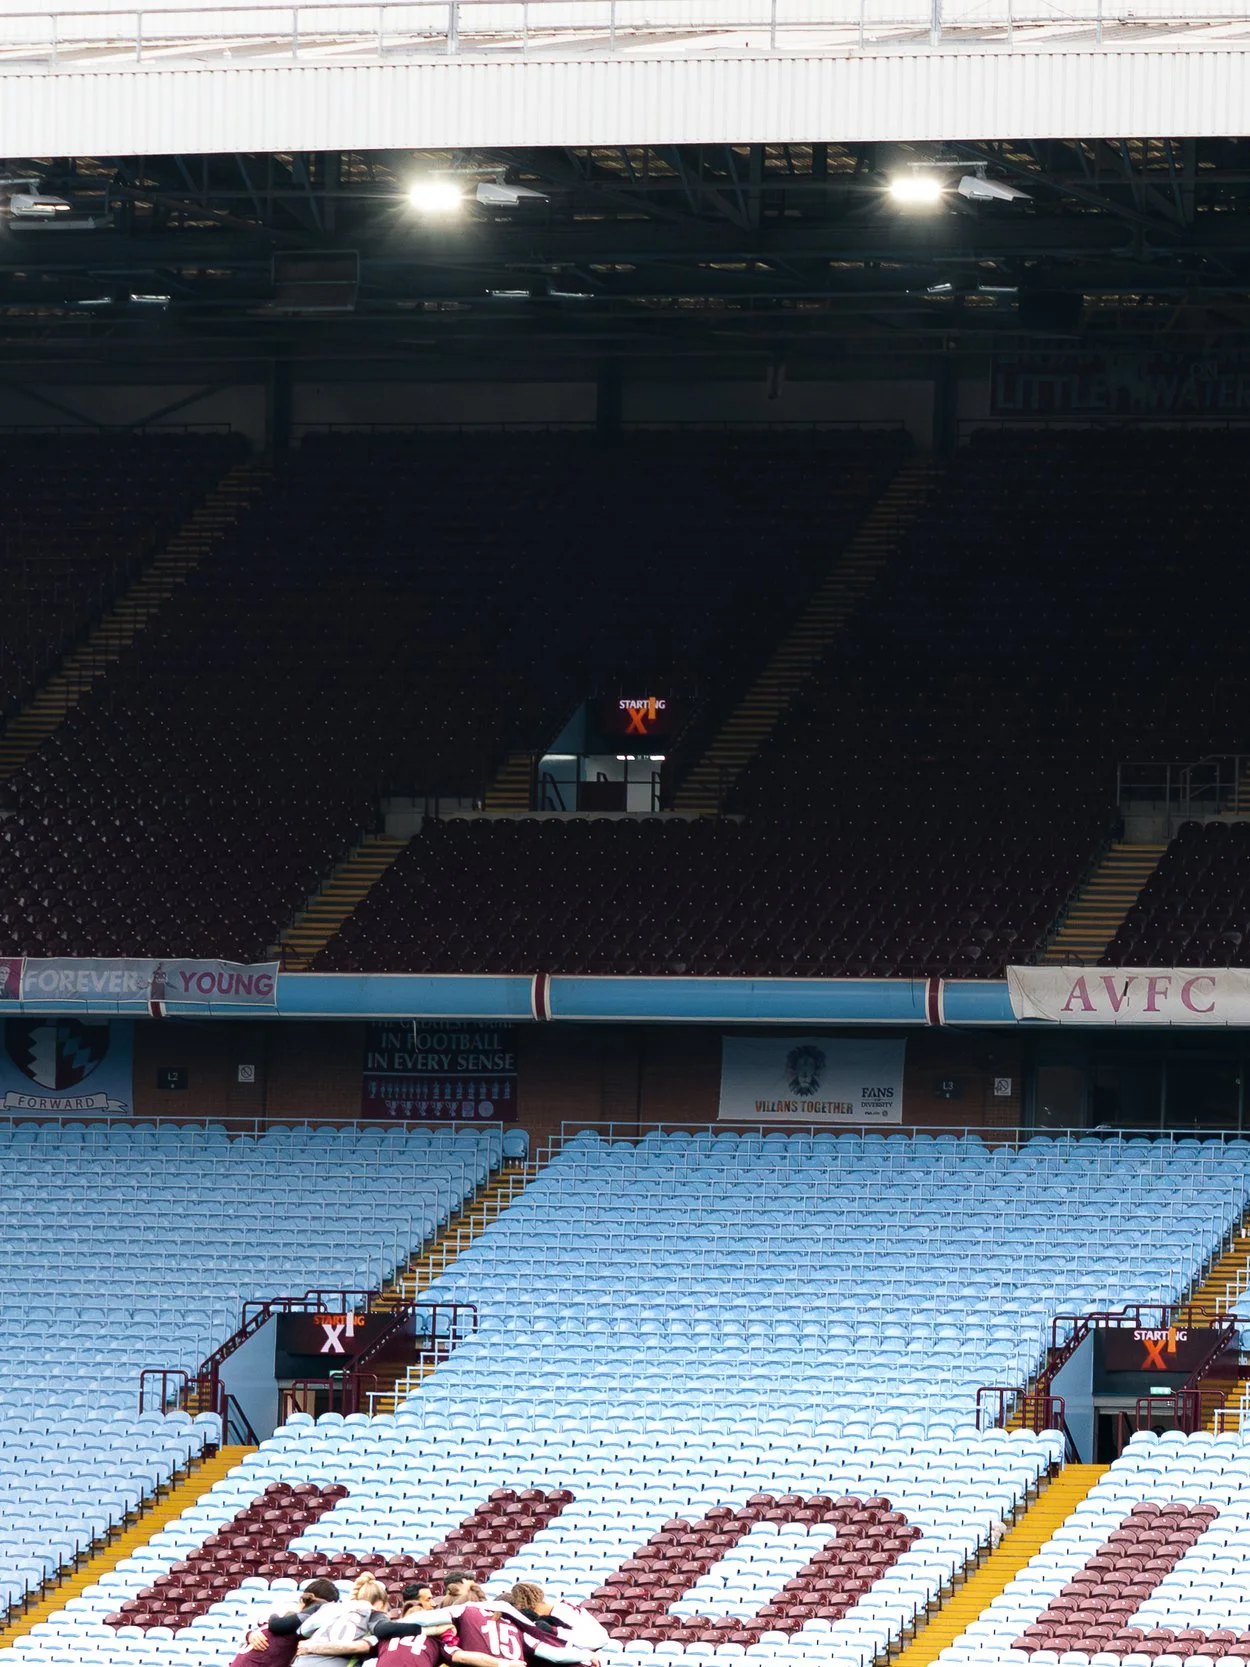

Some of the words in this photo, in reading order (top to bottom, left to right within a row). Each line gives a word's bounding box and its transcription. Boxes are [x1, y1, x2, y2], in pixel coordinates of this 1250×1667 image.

[25, 970, 139, 993] FOREVER
[180, 971, 274, 996] YOUNG
[1060, 975, 1216, 1013] AVFC
[380, 1032, 401, 1049] IN
[407, 1032, 503, 1050] FOOTBALL
[367, 1052, 388, 1068] IN
[394, 1052, 452, 1070] EVERY
[457, 1053, 515, 1070] SENSE
[167, 1071, 179, 1081] L2
[862, 1087, 894, 1098] FANS
[18, 1096, 95, 1109] FORWARD
[755, 1100, 798, 1113] VILLANS
[801, 1101, 853, 1115] TOGETHER
[481, 1619, 521, 1661] 15
